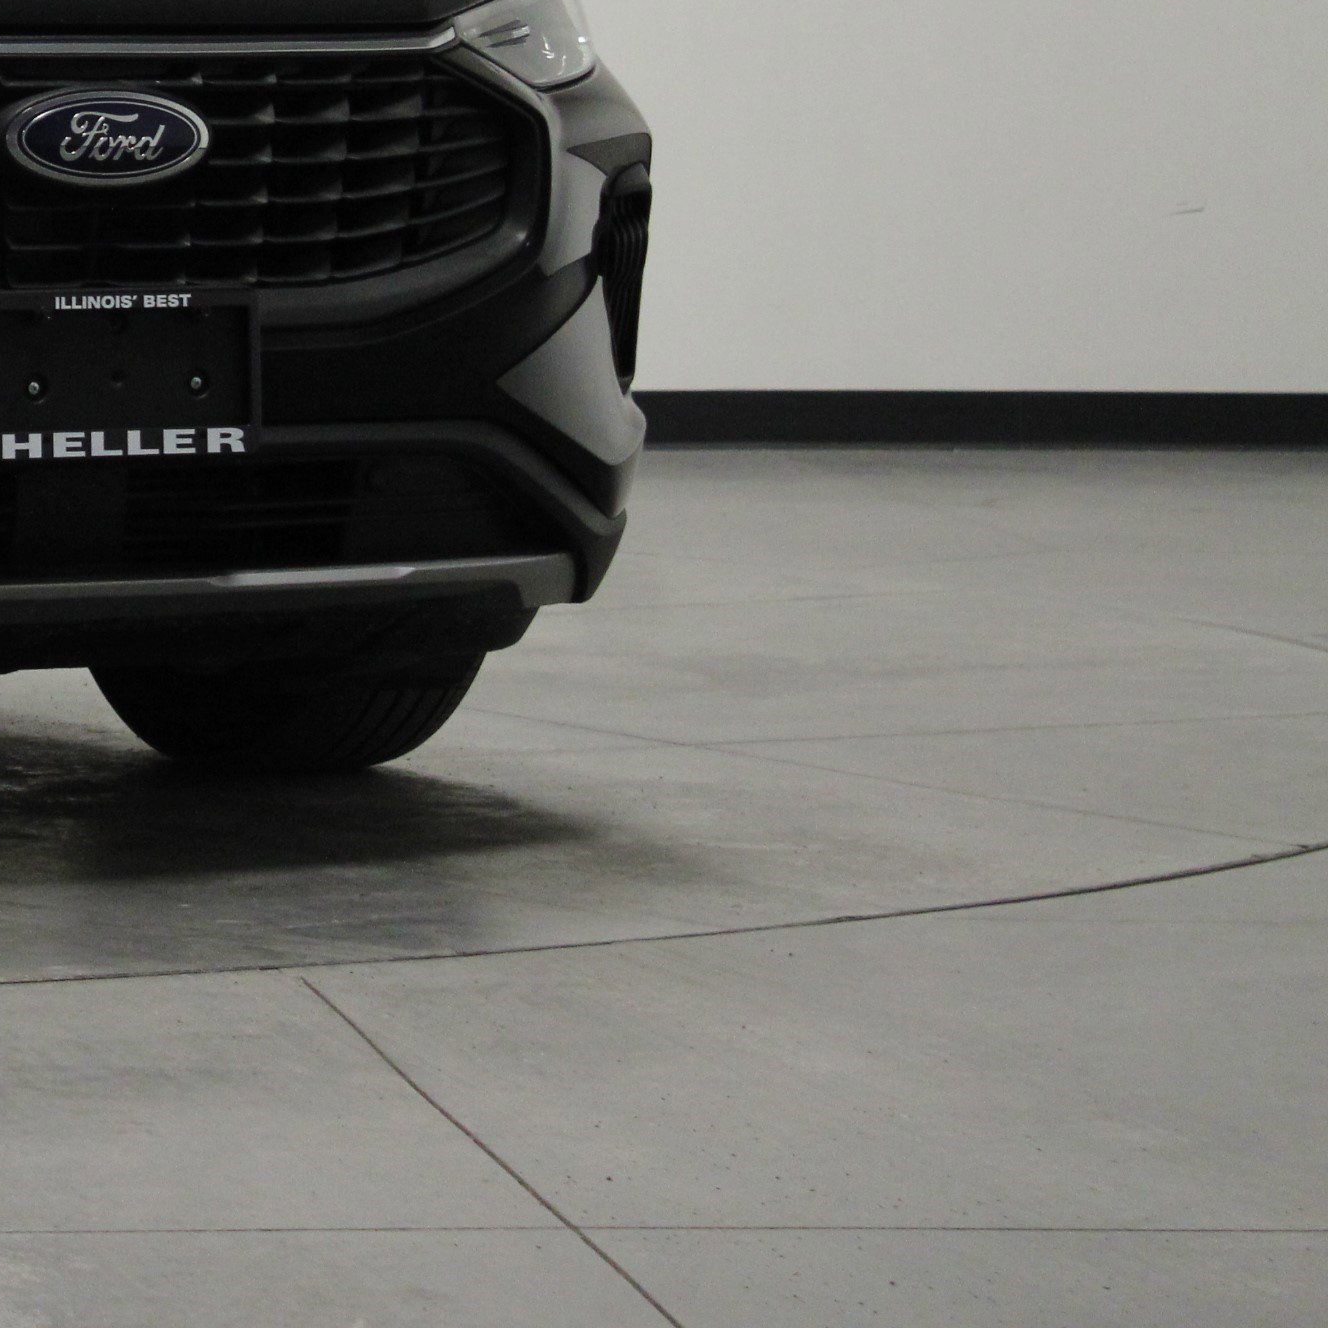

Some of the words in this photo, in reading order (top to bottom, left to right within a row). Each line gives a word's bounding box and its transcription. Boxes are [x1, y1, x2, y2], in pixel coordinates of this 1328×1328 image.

[59, 110, 165, 162] Ford
[143, 293, 192, 309] BEST
[1, 427, 246, 460] HELLER
